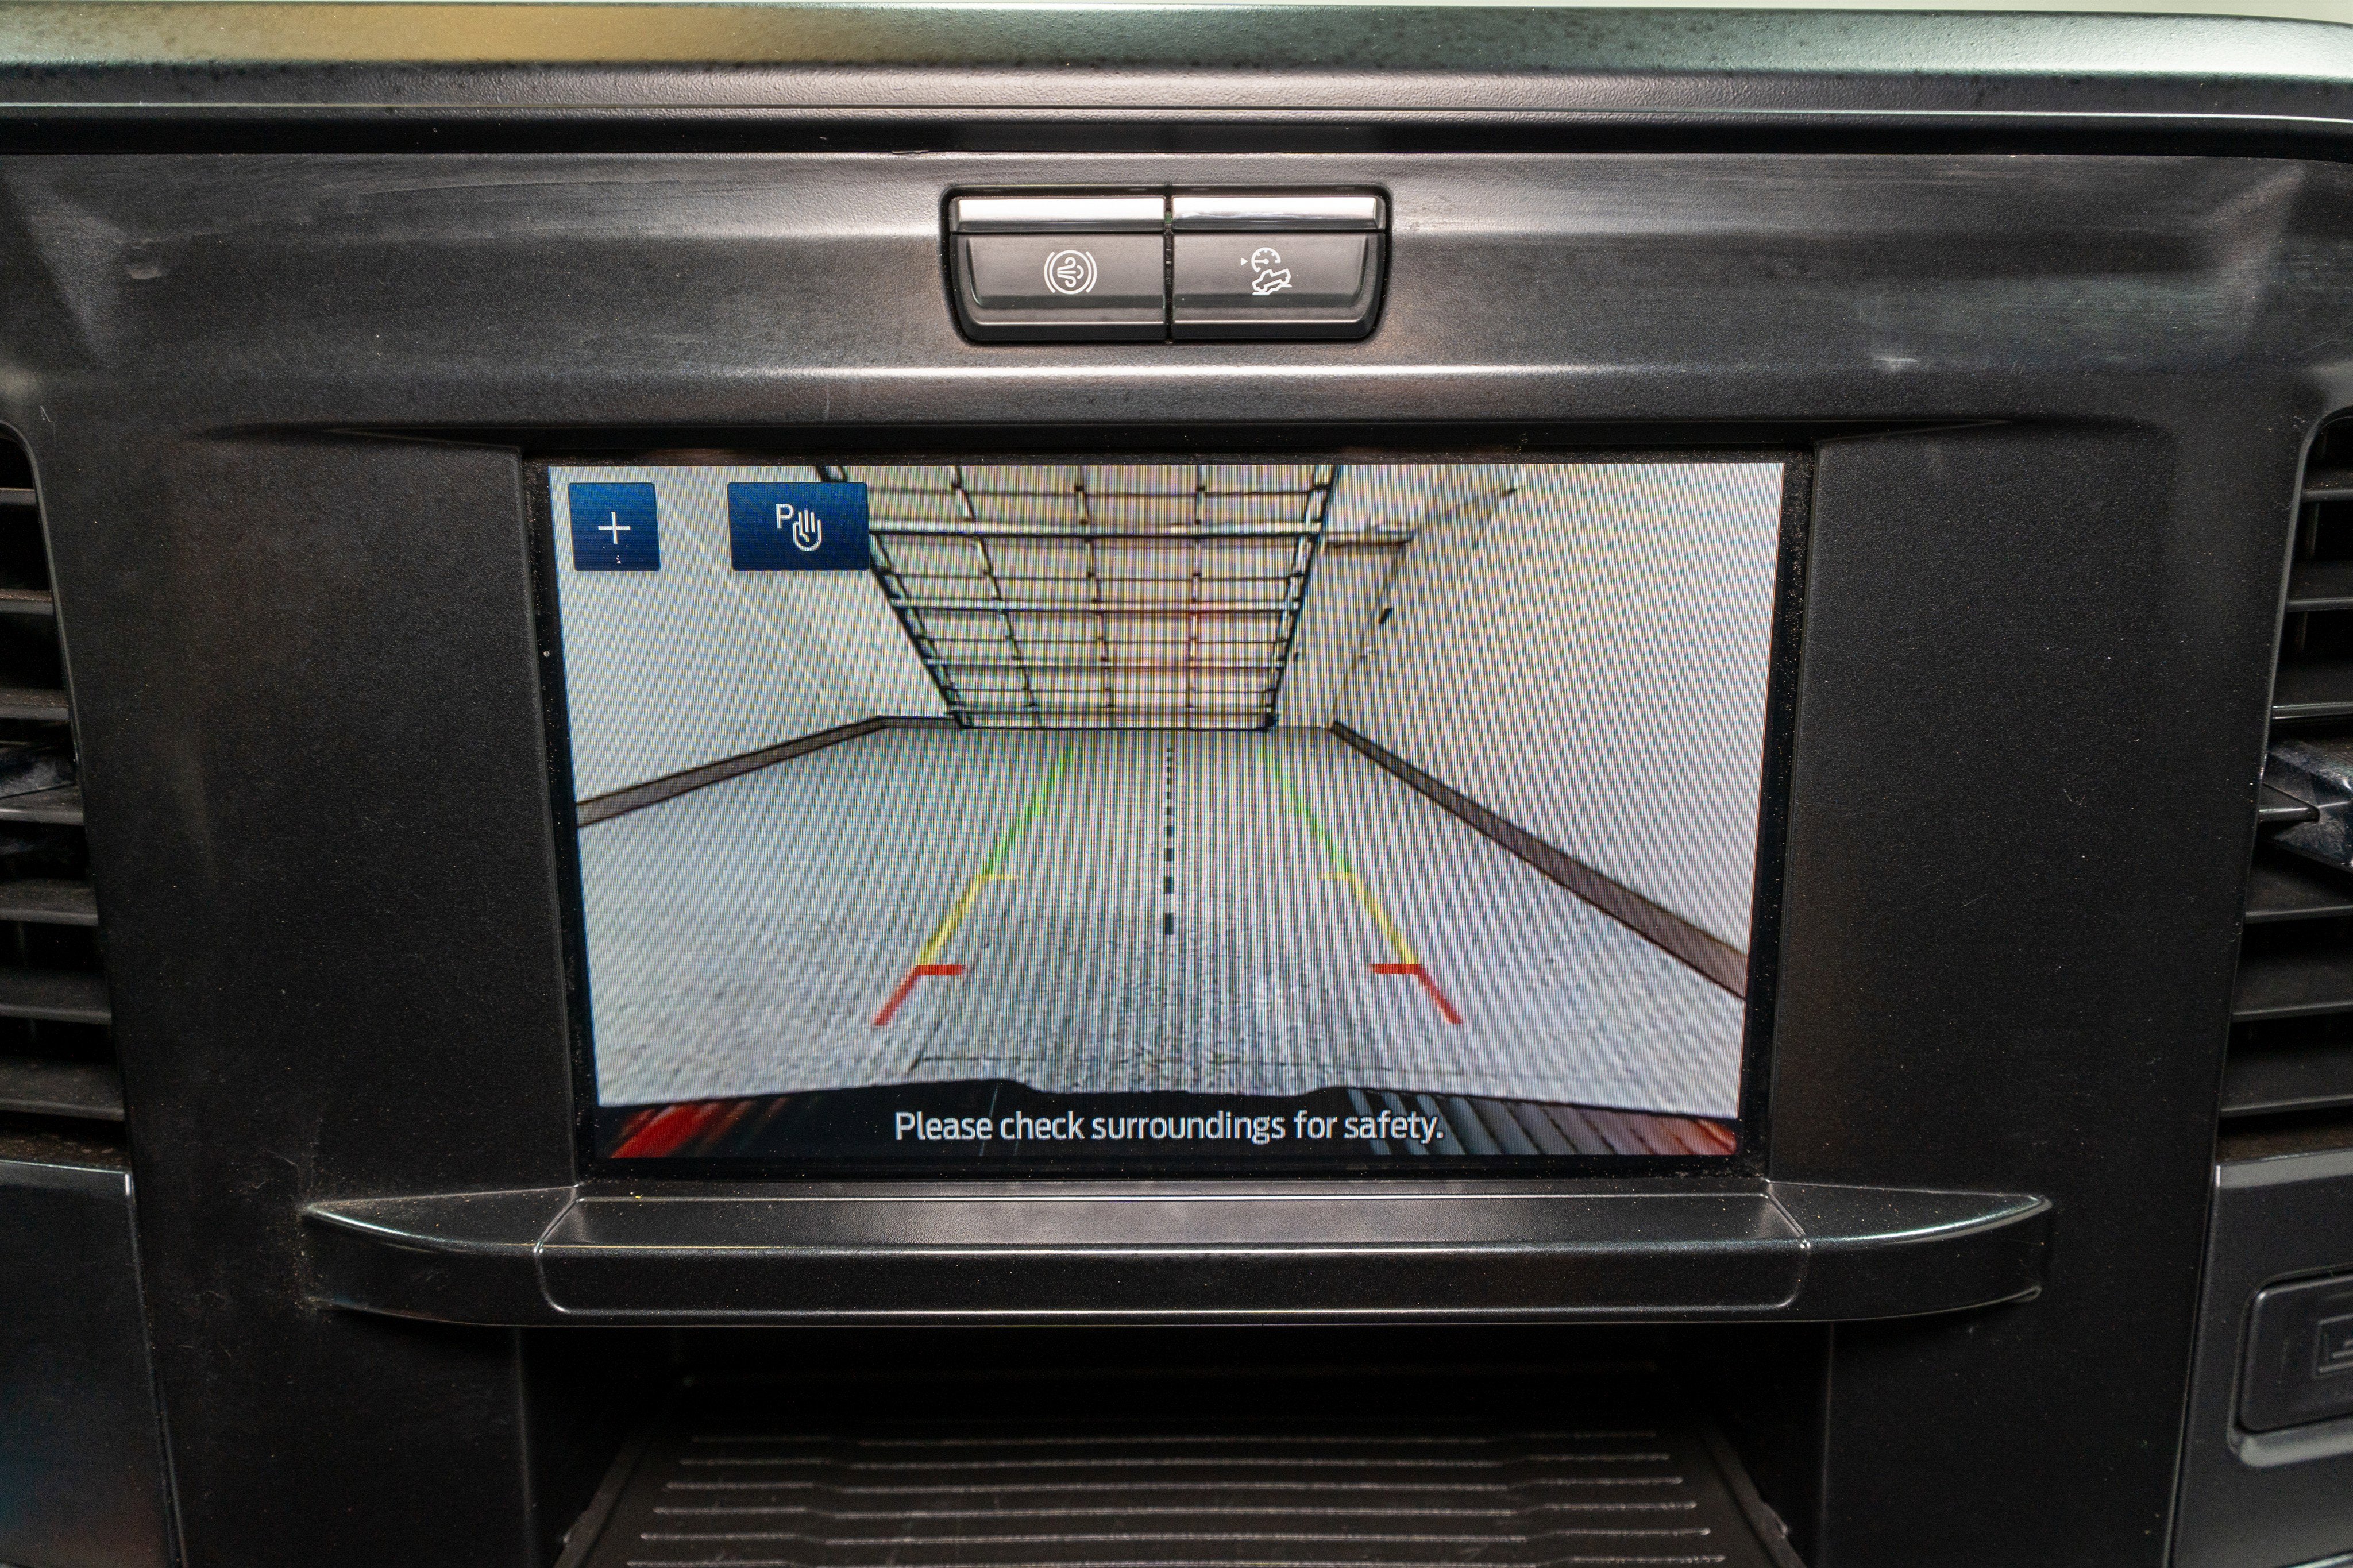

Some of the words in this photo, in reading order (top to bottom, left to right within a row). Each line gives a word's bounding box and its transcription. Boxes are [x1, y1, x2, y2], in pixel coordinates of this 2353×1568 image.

[895, 1111, 993, 1140] Please
[1000, 1111, 1085, 1140] check
[1091, 1110, 1286, 1144] surroundings
[1294, 1110, 1337, 1139] for
[1344, 1110, 1444, 1144] safety.
